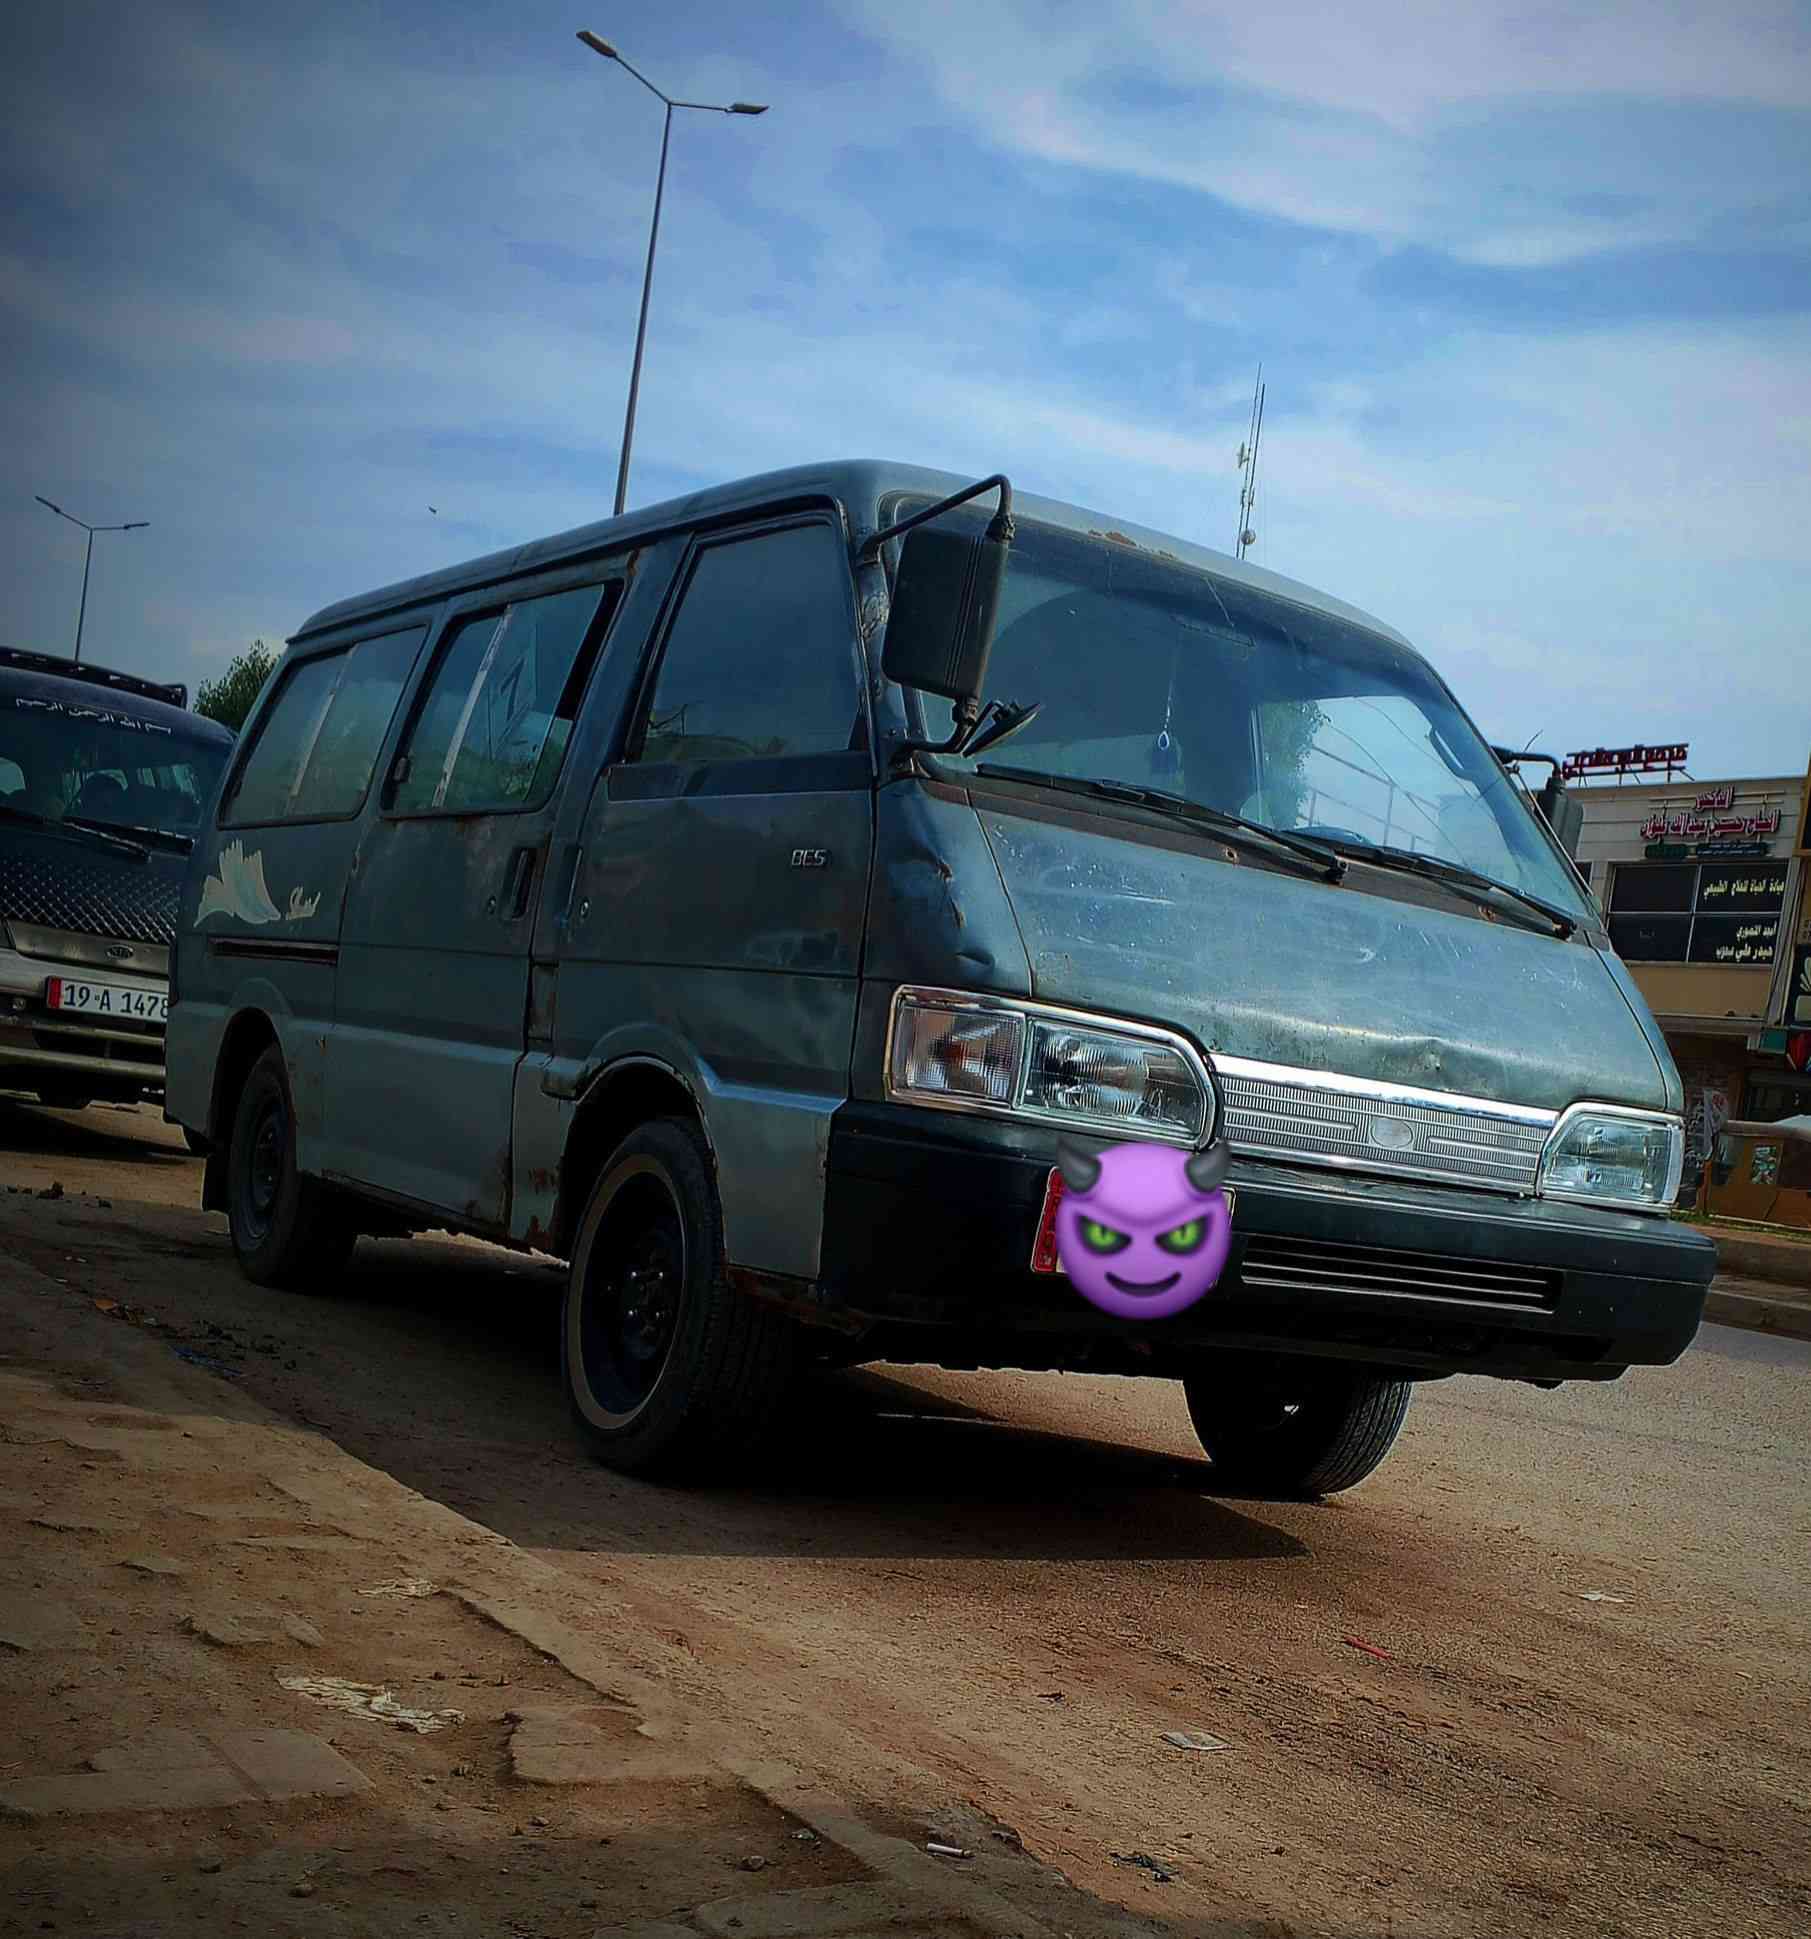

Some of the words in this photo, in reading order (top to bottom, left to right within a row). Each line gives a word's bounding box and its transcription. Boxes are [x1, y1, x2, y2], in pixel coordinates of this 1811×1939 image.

[1735, 943, 1752, 963] علي
[64, 984, 90, 1007] 19
[98, 988, 111, 1011] A
